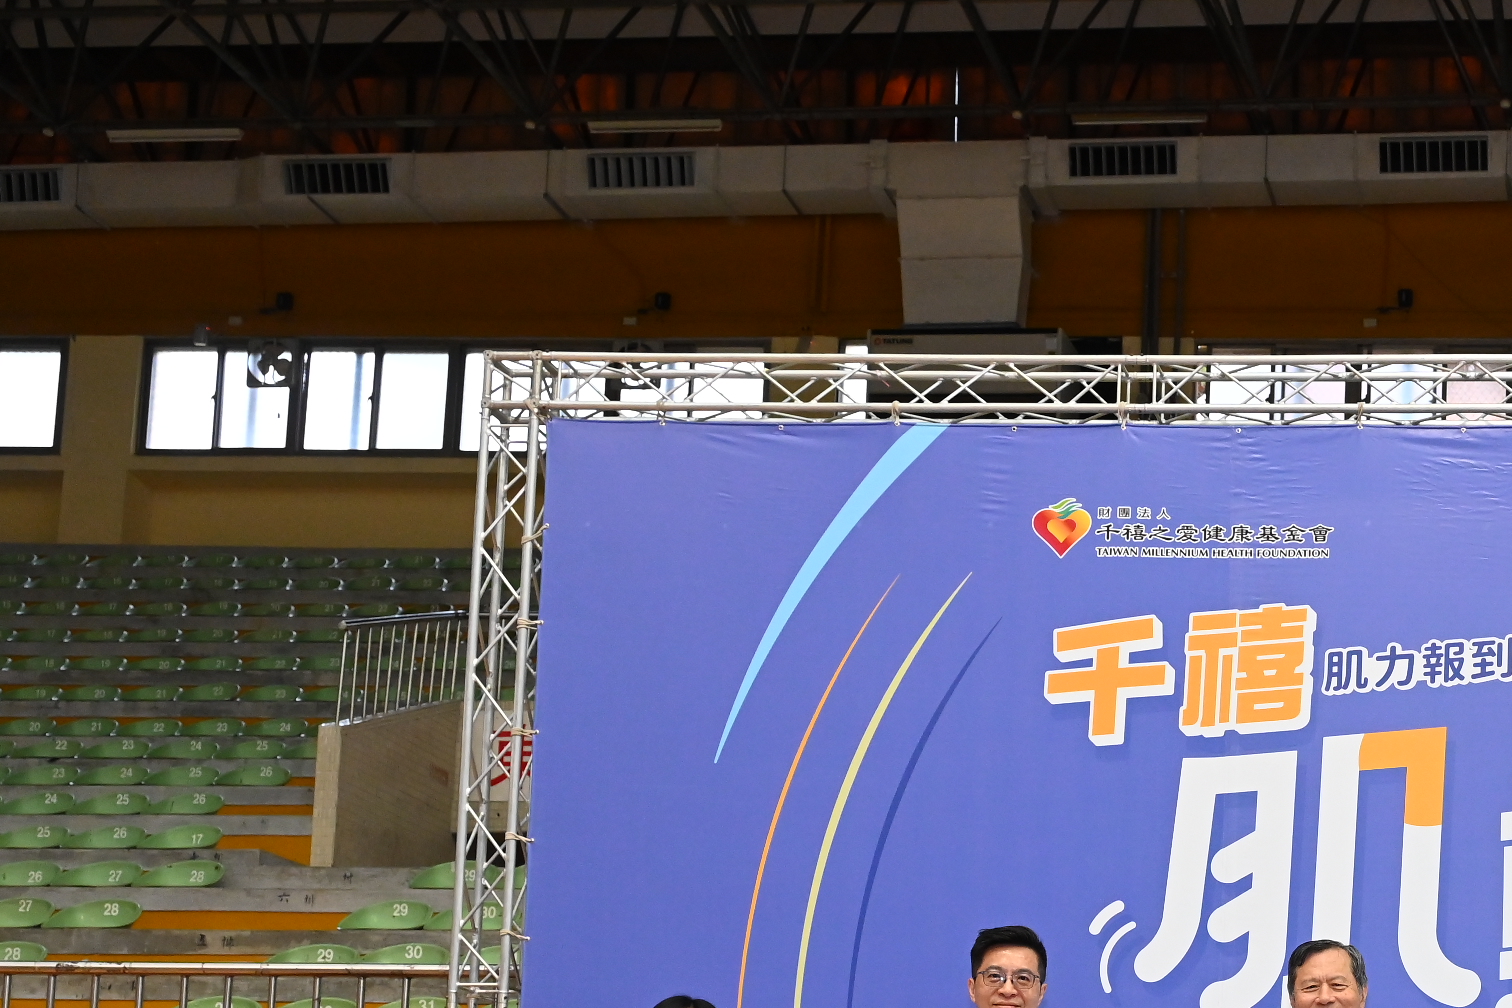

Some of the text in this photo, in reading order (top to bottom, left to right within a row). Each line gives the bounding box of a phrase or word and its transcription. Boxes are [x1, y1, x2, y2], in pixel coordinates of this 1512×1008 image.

[1097, 507, 1171, 519] 財團法人
[1095, 523, 1334, 543] 千禧之愛健康基金會
[1096, 547, 1330, 558] TAIWAN MILLENNIUM HEALTH FOUNDATION
[1045, 603, 1316, 745] 千禧
[35, 689, 46, 698] 19
[94, 689, 106, 699] 20
[155, 689, 166, 699] 21
[212, 685, 224, 696] 22
[29, 722, 41, 732] 20
[91, 722, 101, 732] 21
[151, 723, 164, 733] 22
[216, 722, 228, 733] 23
[280, 722, 291, 732] 24
[56, 740, 67, 750] 22
[122, 739, 134, 750] 23
[190, 740, 202, 751] 24
[256, 740, 268, 751] 25
[52, 768, 65, 779] 23
[120, 767, 133, 778] 24
[189, 767, 202, 777] 25
[260, 766, 273, 777] 26
[45, 793, 57, 804] 24
[116, 794, 129, 805] 25
[193, 793, 206, 804] 26
[37, 826, 50, 838] 25
[113, 827, 127, 839] 26
[191, 834, 203, 844] 17
[27, 870, 43, 883] 26
[108, 870, 122, 883] 27
[189, 870, 205, 883] 28
[18, 900, 32, 912] 27
[103, 903, 119, 916] 28
[393, 903, 408, 916] 29
[3, 947, 21, 961] 28
[317, 949, 334, 962] 29
[405, 945, 422, 959] 30
